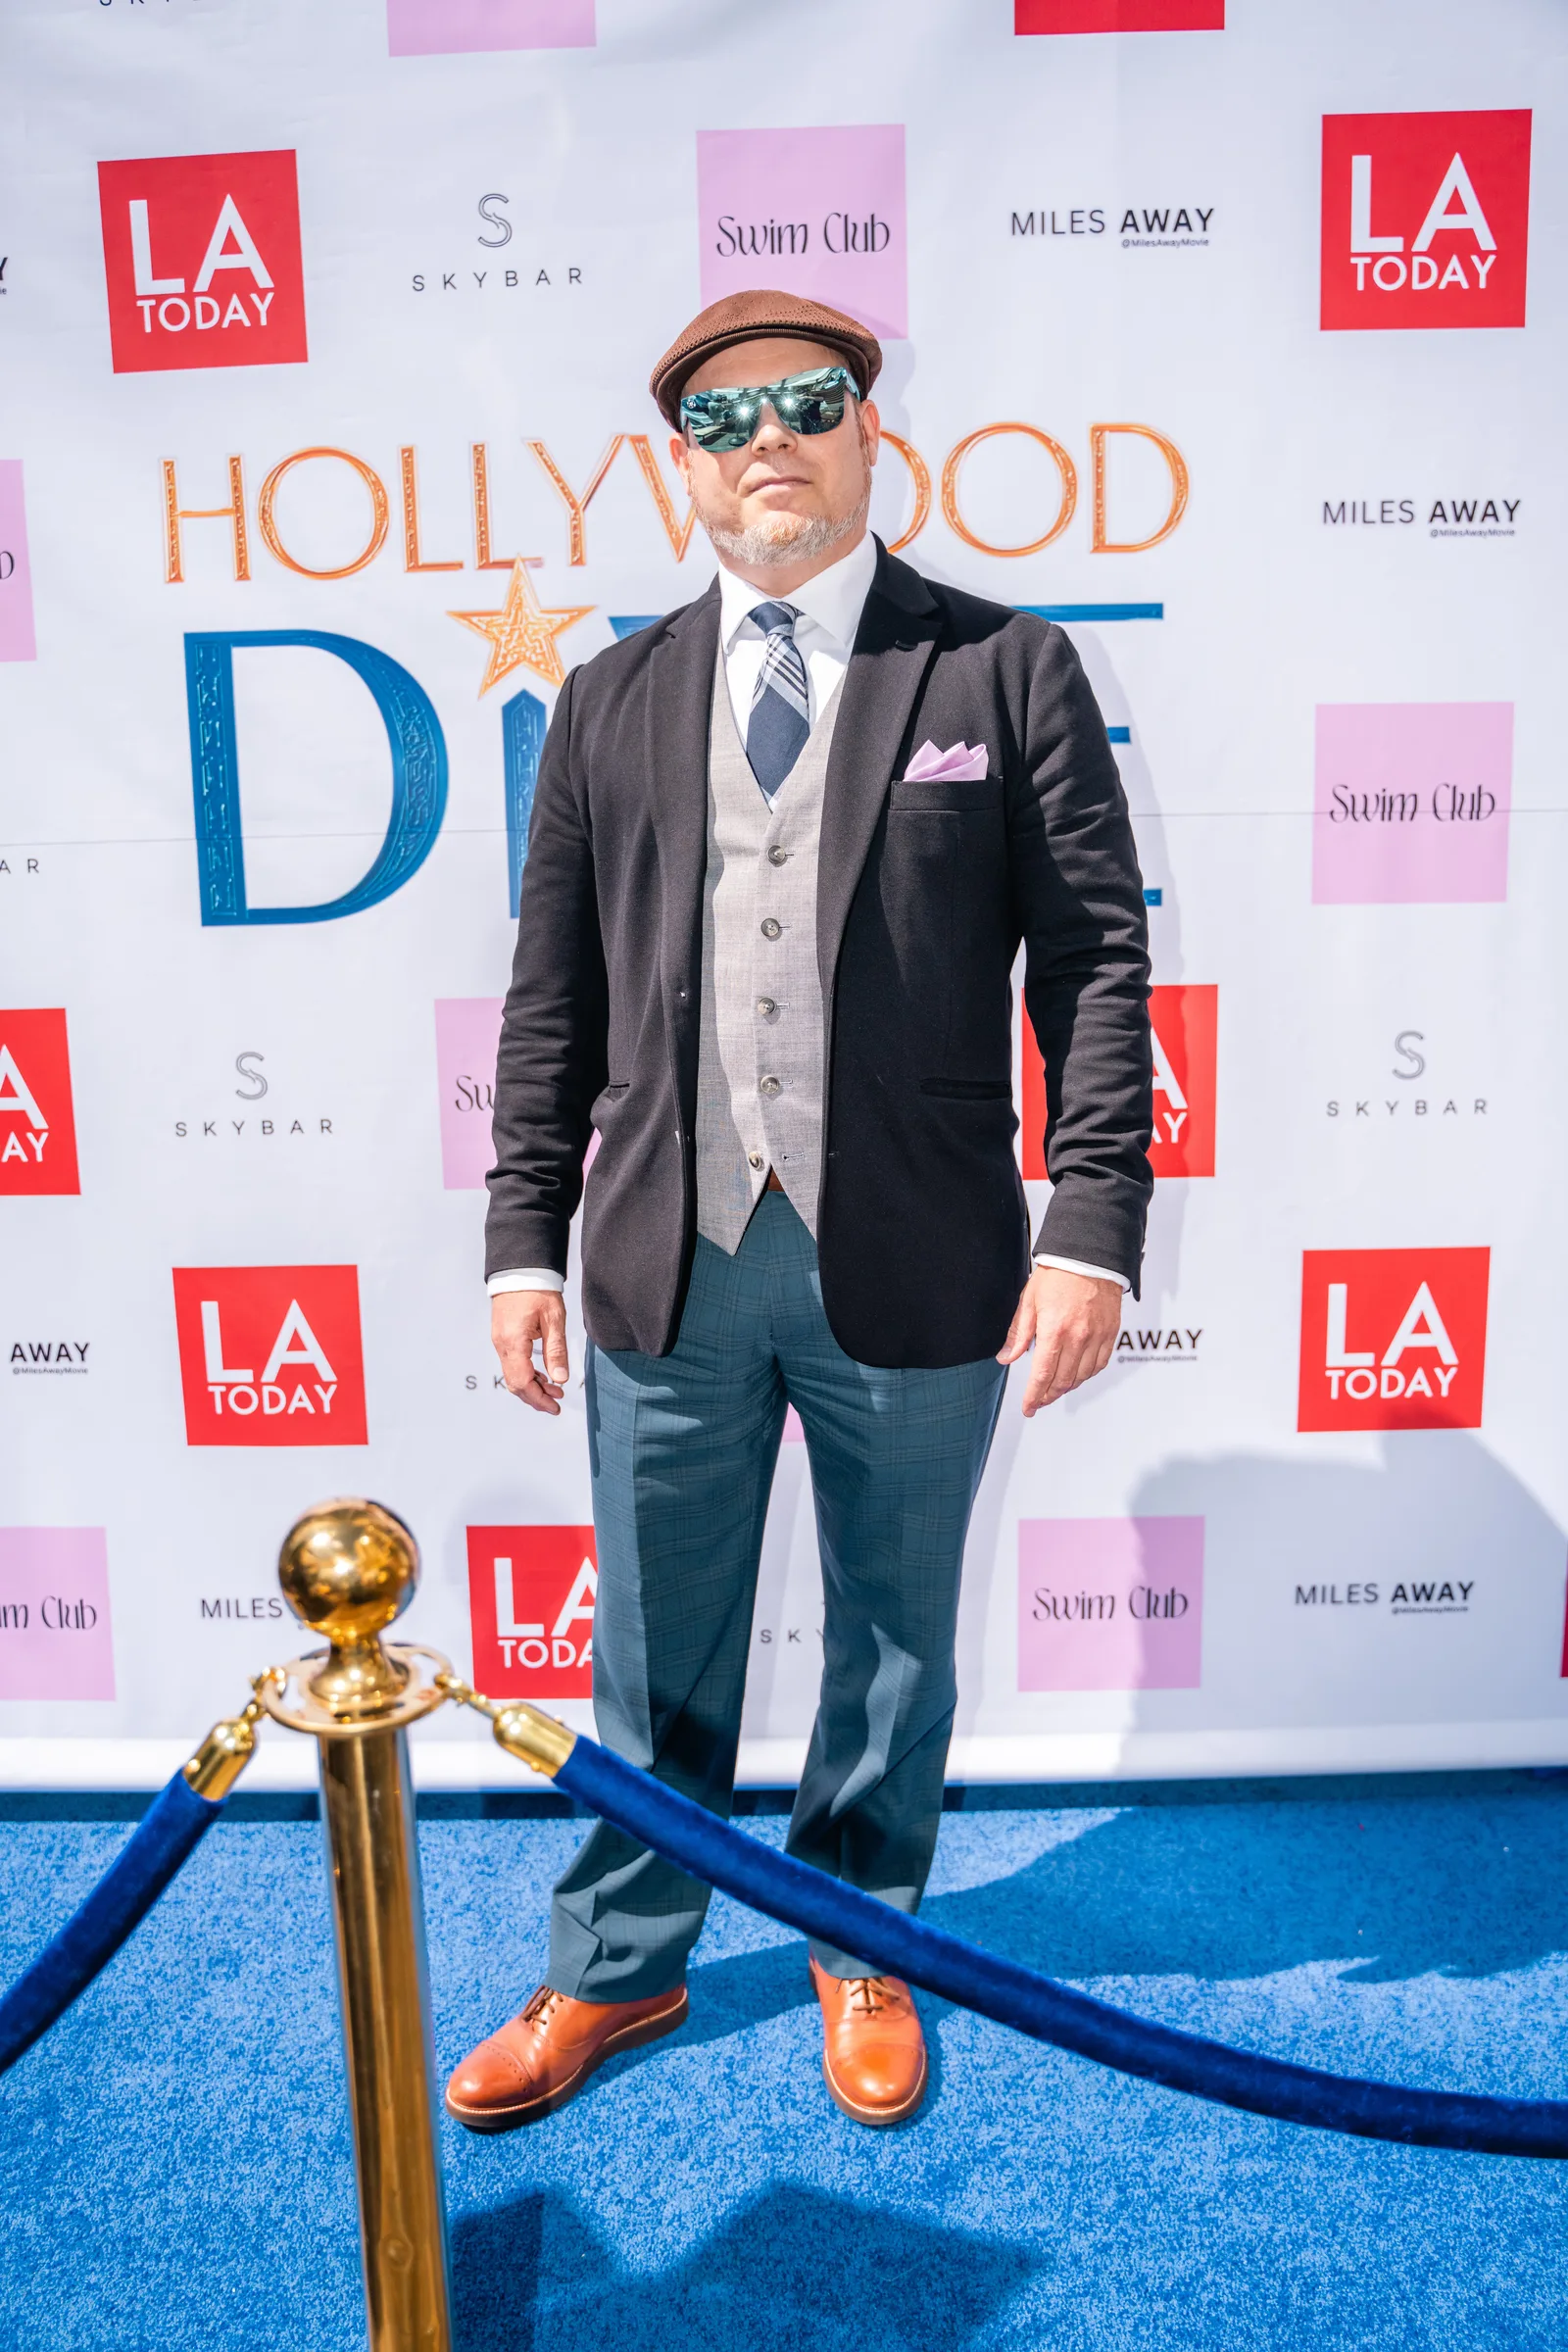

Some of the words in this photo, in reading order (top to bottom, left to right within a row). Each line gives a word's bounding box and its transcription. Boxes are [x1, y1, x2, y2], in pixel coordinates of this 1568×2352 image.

[1350, 153, 1496, 253] LA
[716, 217, 808, 256] Swim
[824, 213, 890, 253] Club
[1012, 210, 1104, 235] MILES
[1120, 209, 1213, 233] AWAY
[129, 194, 274, 296] LA
[1120, 238, 1210, 249] @MilesAwayMovie
[413, 268, 581, 291] SKYBAR
[1350, 255, 1496, 291] TODAY
[135, 292, 274, 334] TODAY
[159, 421, 1190, 582] HOLLYOD
[1324, 501, 1414, 523] MILES
[1429, 500, 1520, 523] AWAY
[1429, 528, 1516, 539] @MilesAwayMovie
[1330, 785, 1417, 821] Swim
[1433, 784, 1494, 820] Club
[1328, 1100, 1486, 1116] SKYBAR
[176, 1119, 331, 1137] SKYBAR
[1116, 1329, 1202, 1350] AWAY
[1326, 1282, 1458, 1367] LA
[11, 1343, 88, 1362] AWAY
[201, 1299, 337, 1383] LA
[1325, 1367, 1458, 1399] TODAY
[208, 1384, 337, 1415] TODAY
[202, 1598, 282, 1618] MILES
[493, 1555, 598, 1638] LA
[1033, 1589, 1114, 1620] Swim
[1130, 1587, 1188, 1618] Club
[1296, 1584, 1378, 1604] MILES
[1392, 1582, 1473, 1602] AWAY
[42, 1596, 96, 1629] Club
